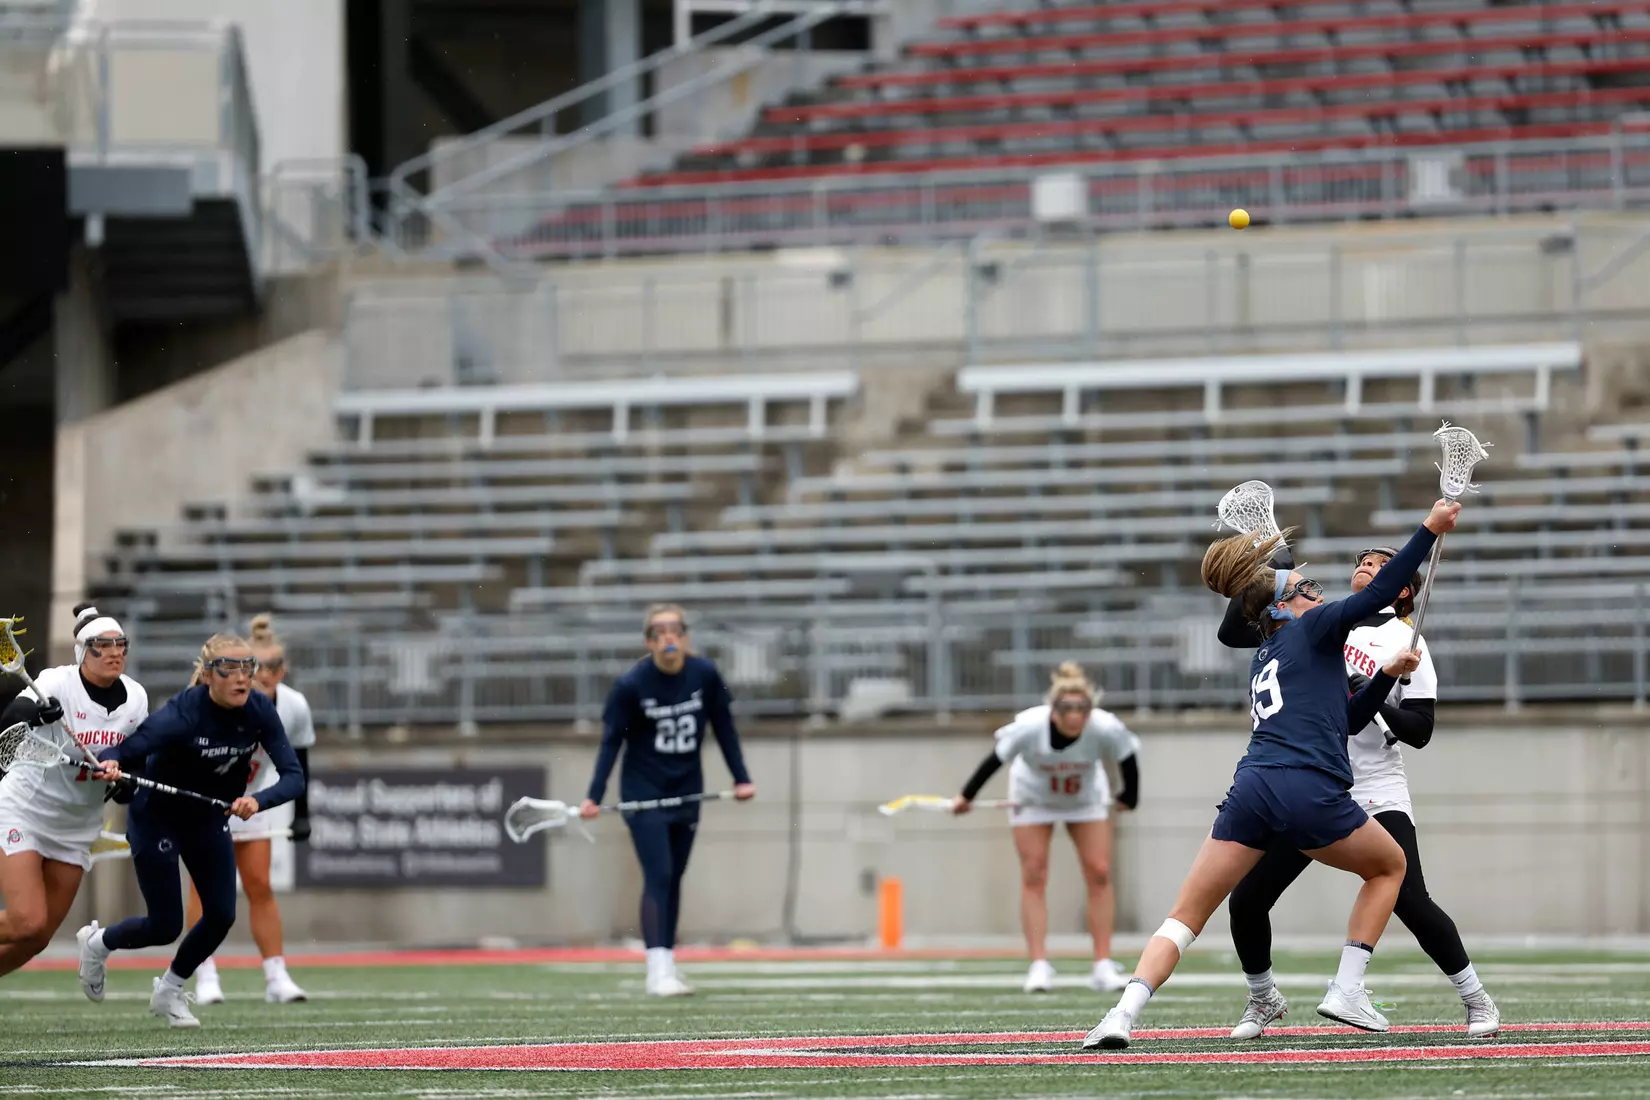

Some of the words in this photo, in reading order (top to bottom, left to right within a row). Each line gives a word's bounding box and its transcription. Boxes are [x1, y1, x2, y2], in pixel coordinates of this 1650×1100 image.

[1250, 658, 1284, 731] 19
[655, 713, 697, 753] 22
[1050, 774, 1082, 794] 16
